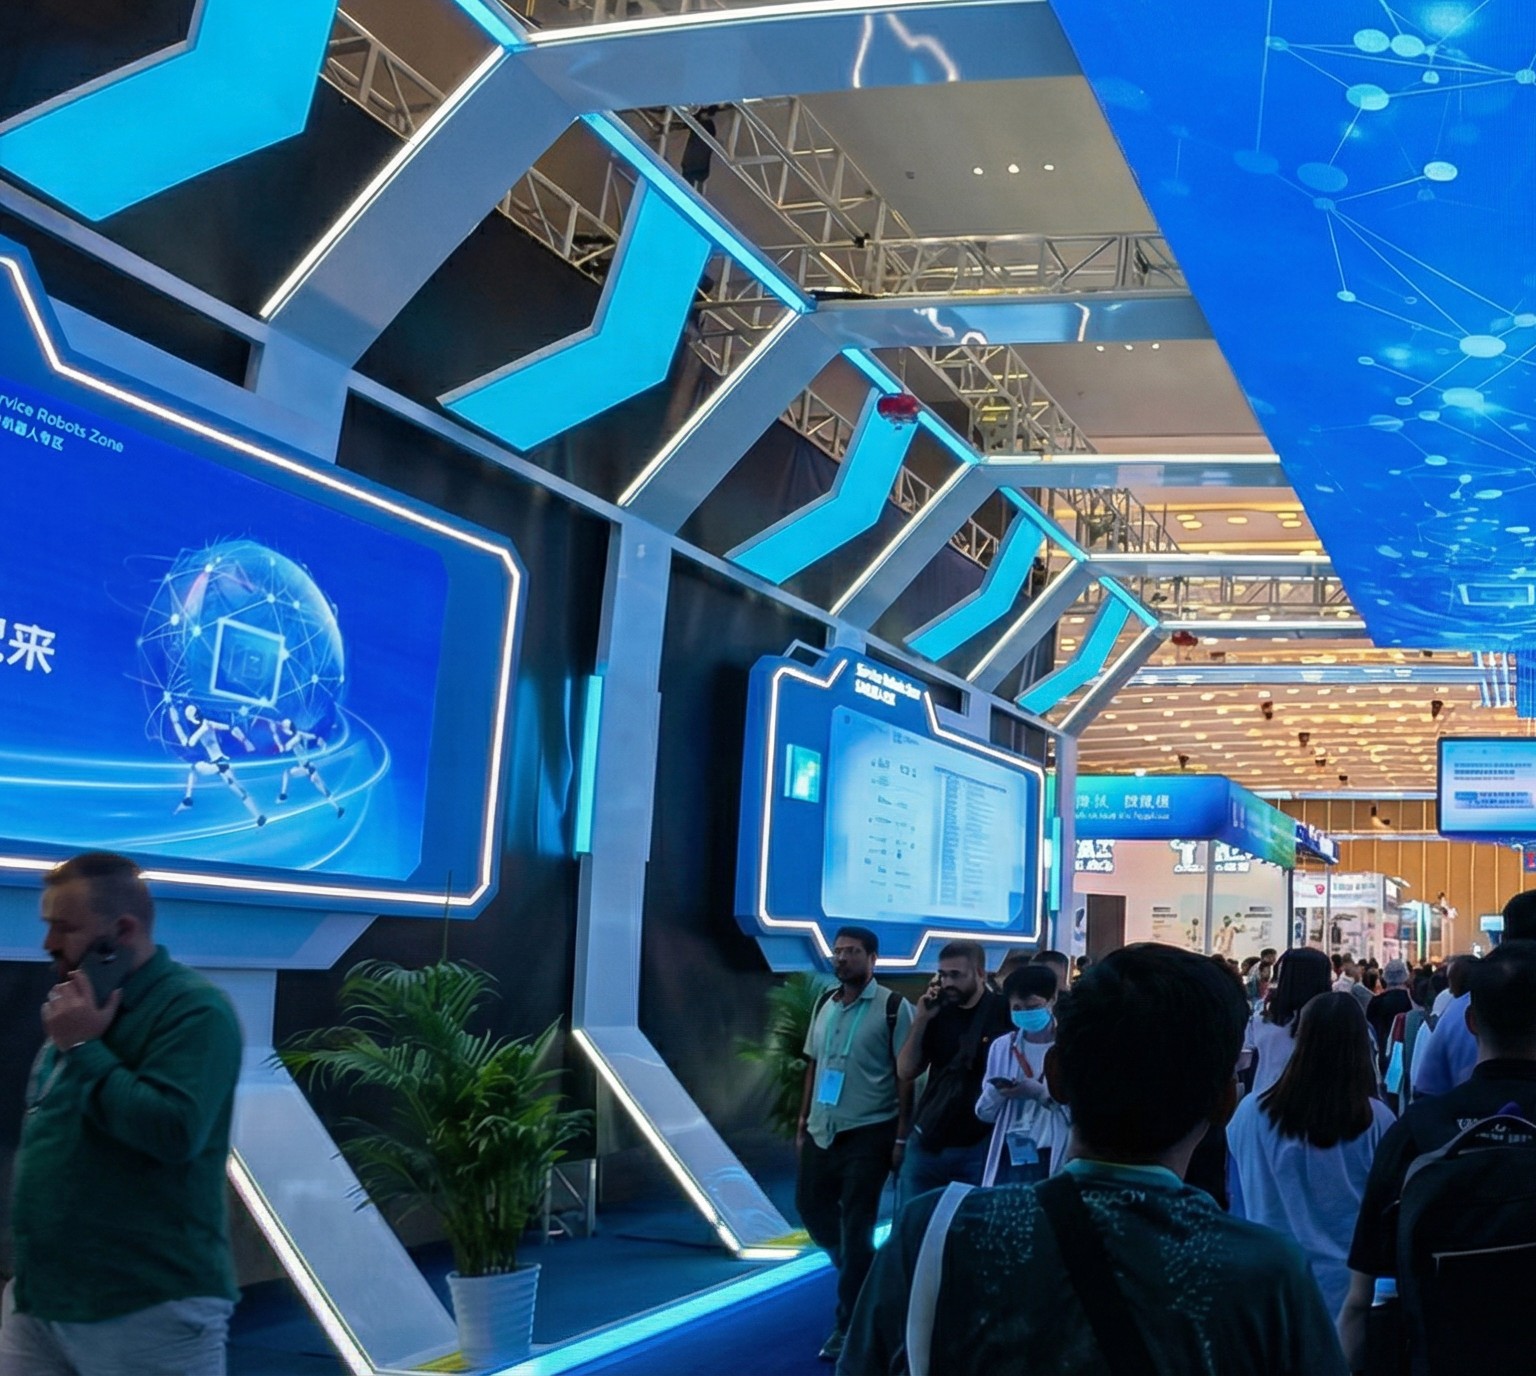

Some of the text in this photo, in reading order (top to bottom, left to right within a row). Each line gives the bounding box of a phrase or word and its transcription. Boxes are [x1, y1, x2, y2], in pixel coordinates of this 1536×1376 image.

[36, 407, 87, 439] Robots
[88, 428, 124, 453] Zone
[0, 617, 56, 674] 来
